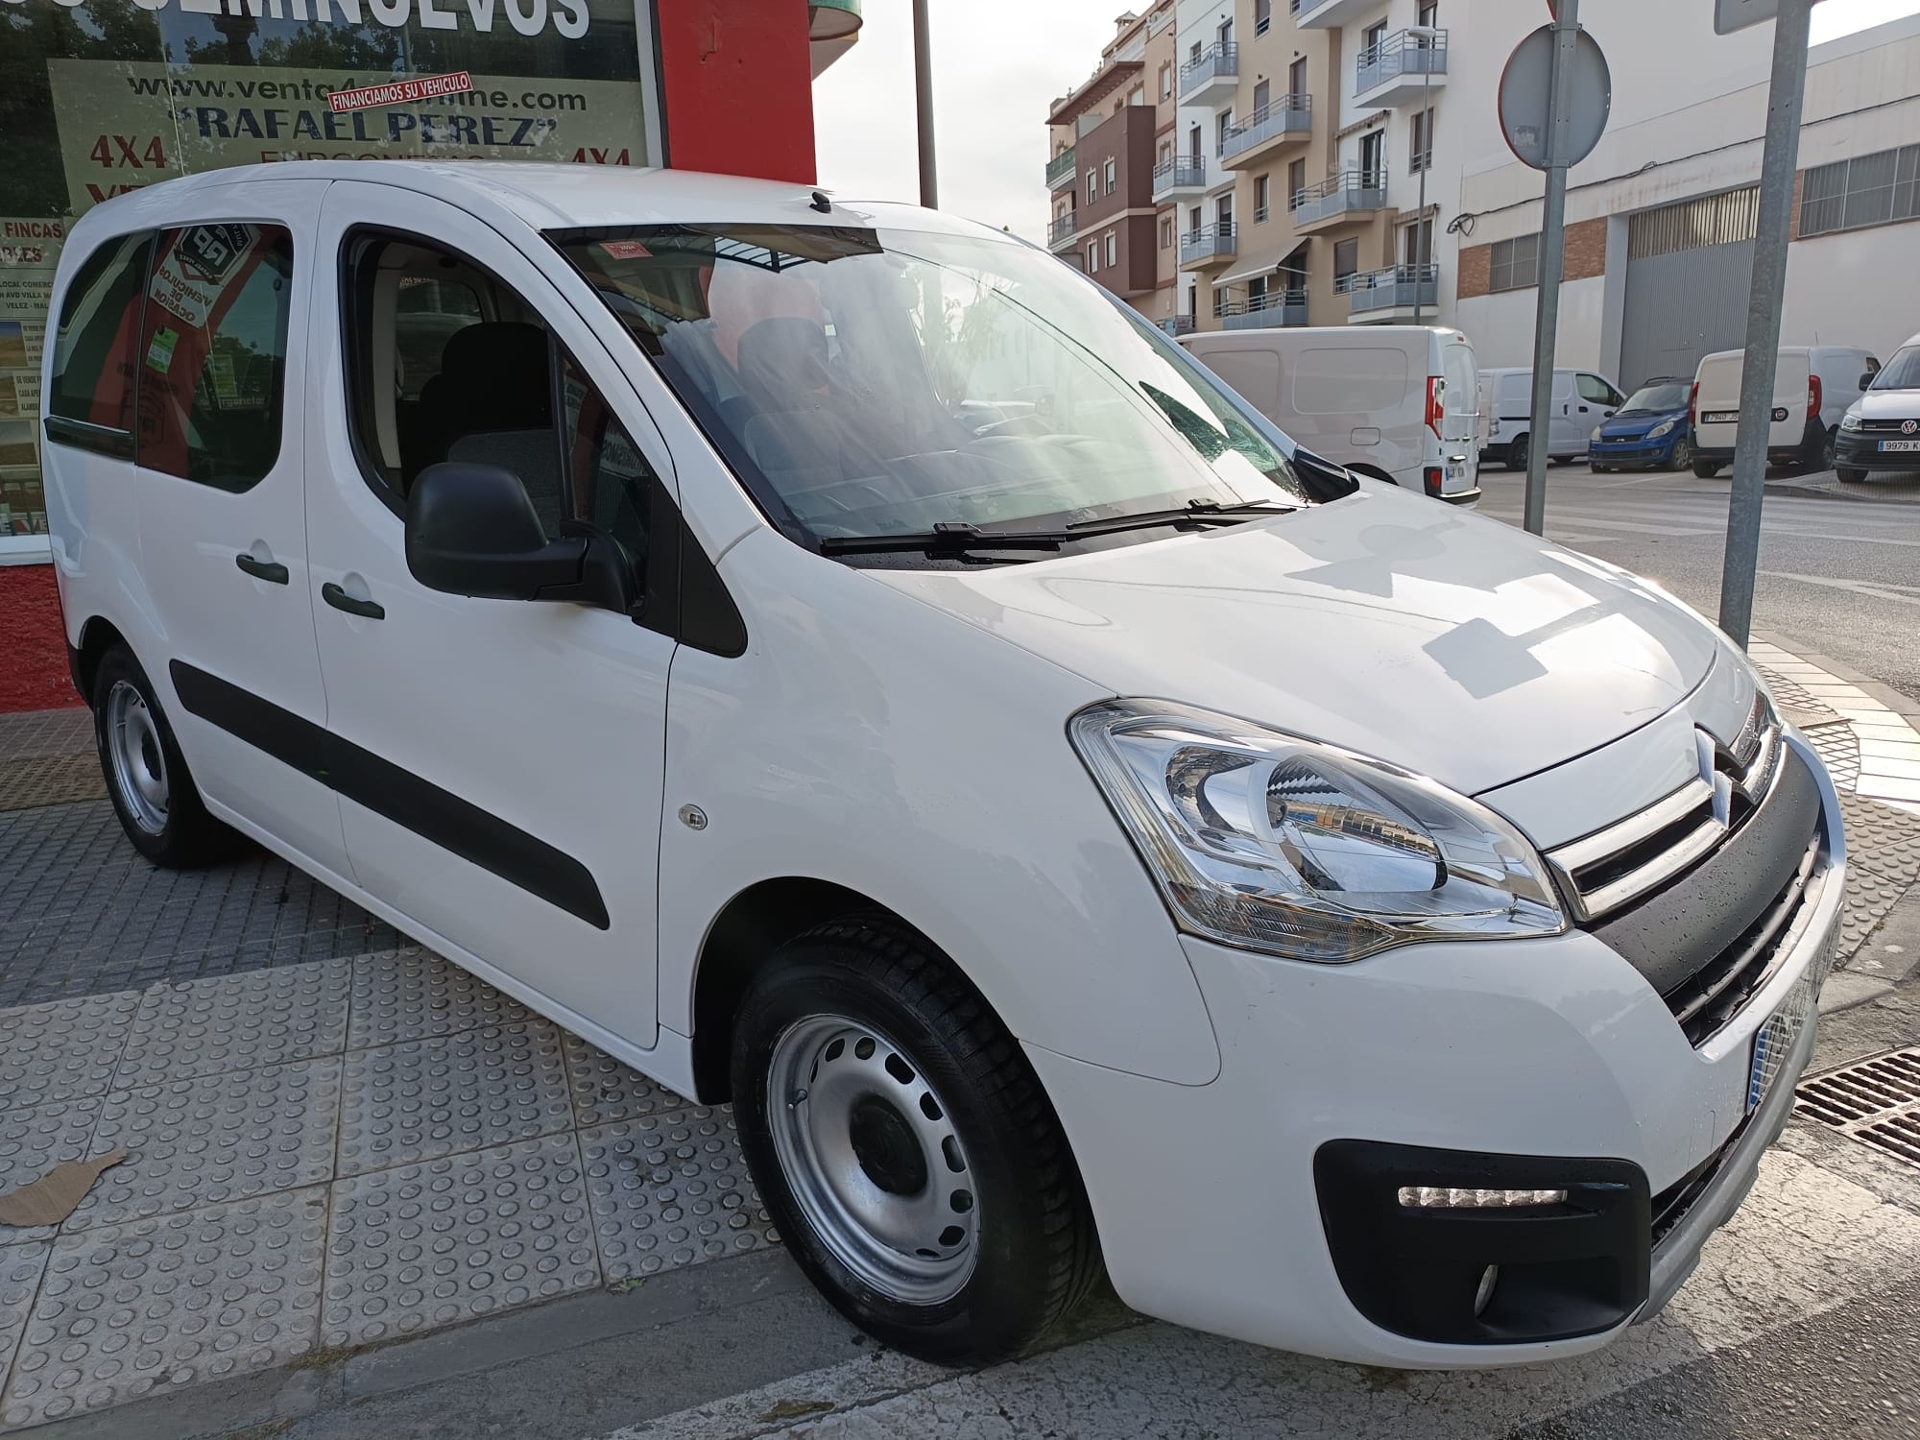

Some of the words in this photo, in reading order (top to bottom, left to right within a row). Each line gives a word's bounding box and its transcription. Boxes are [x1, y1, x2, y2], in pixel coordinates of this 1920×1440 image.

[332, 85, 403, 110] FINANCIAMOS
[406, 81, 418, 98] SU
[421, 74, 469, 95] VEHICULO
[90, 134, 168, 169] 4X4
[4, 222, 63, 239] FINCAS
[1886, 441, 1909, 450] 9979
